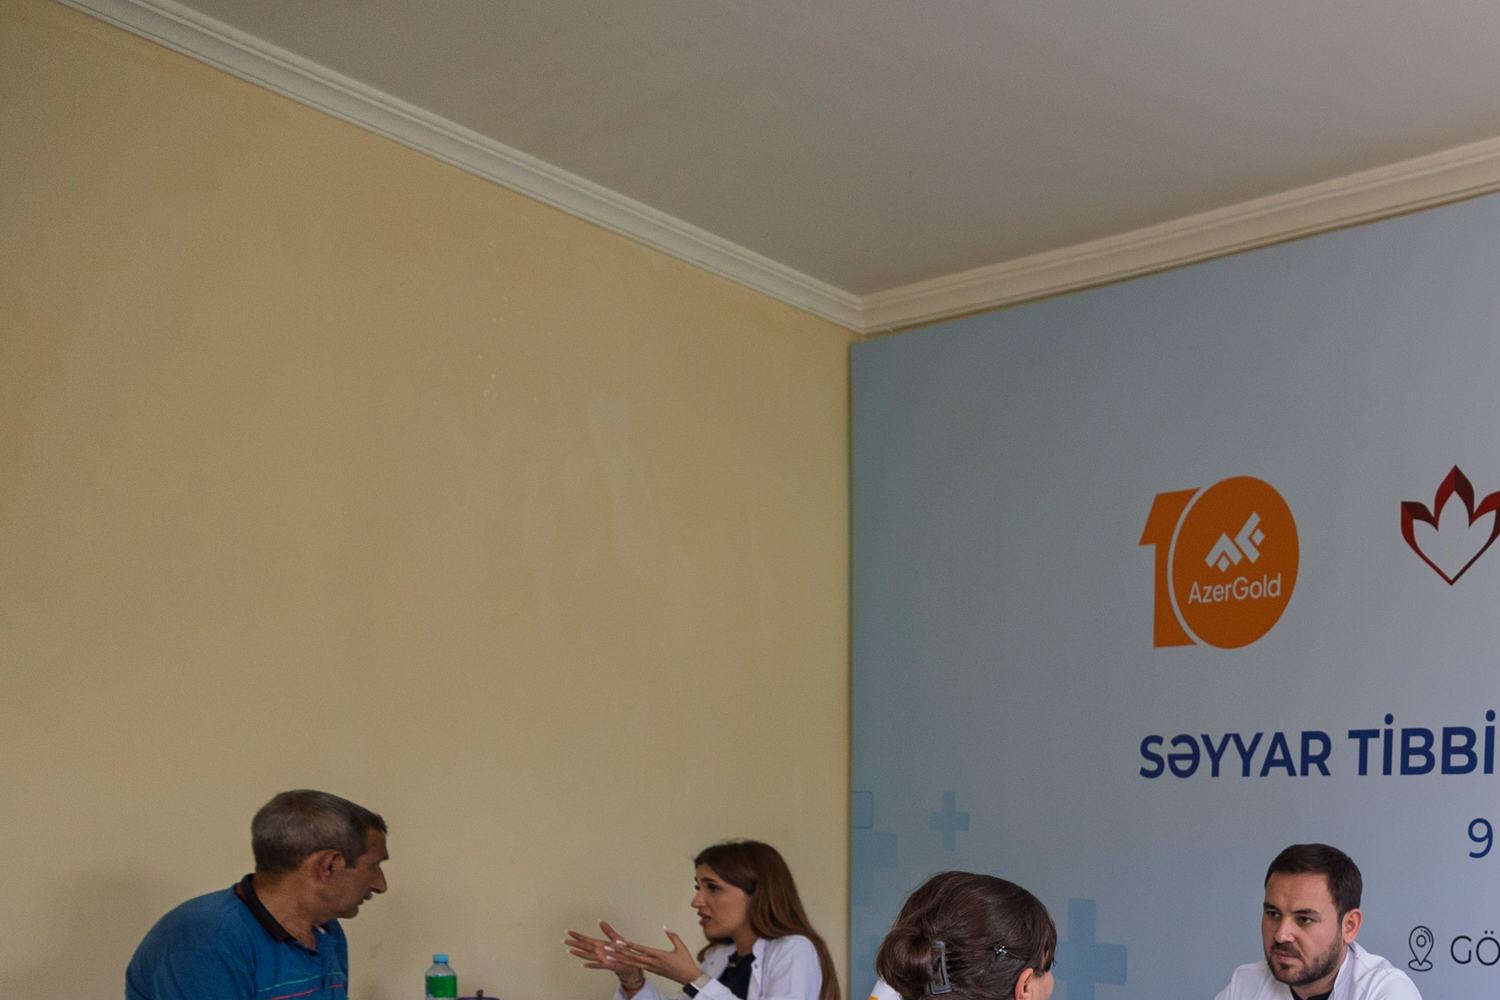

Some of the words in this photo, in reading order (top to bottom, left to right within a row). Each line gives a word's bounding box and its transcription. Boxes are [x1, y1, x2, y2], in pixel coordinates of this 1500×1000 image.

[1188, 573, 1281, 605] AzerGold
[1139, 731, 1332, 779] SƏYYAR
[1348, 713, 1496, 776] TİBBİ
[1467, 818, 1494, 859] 9
